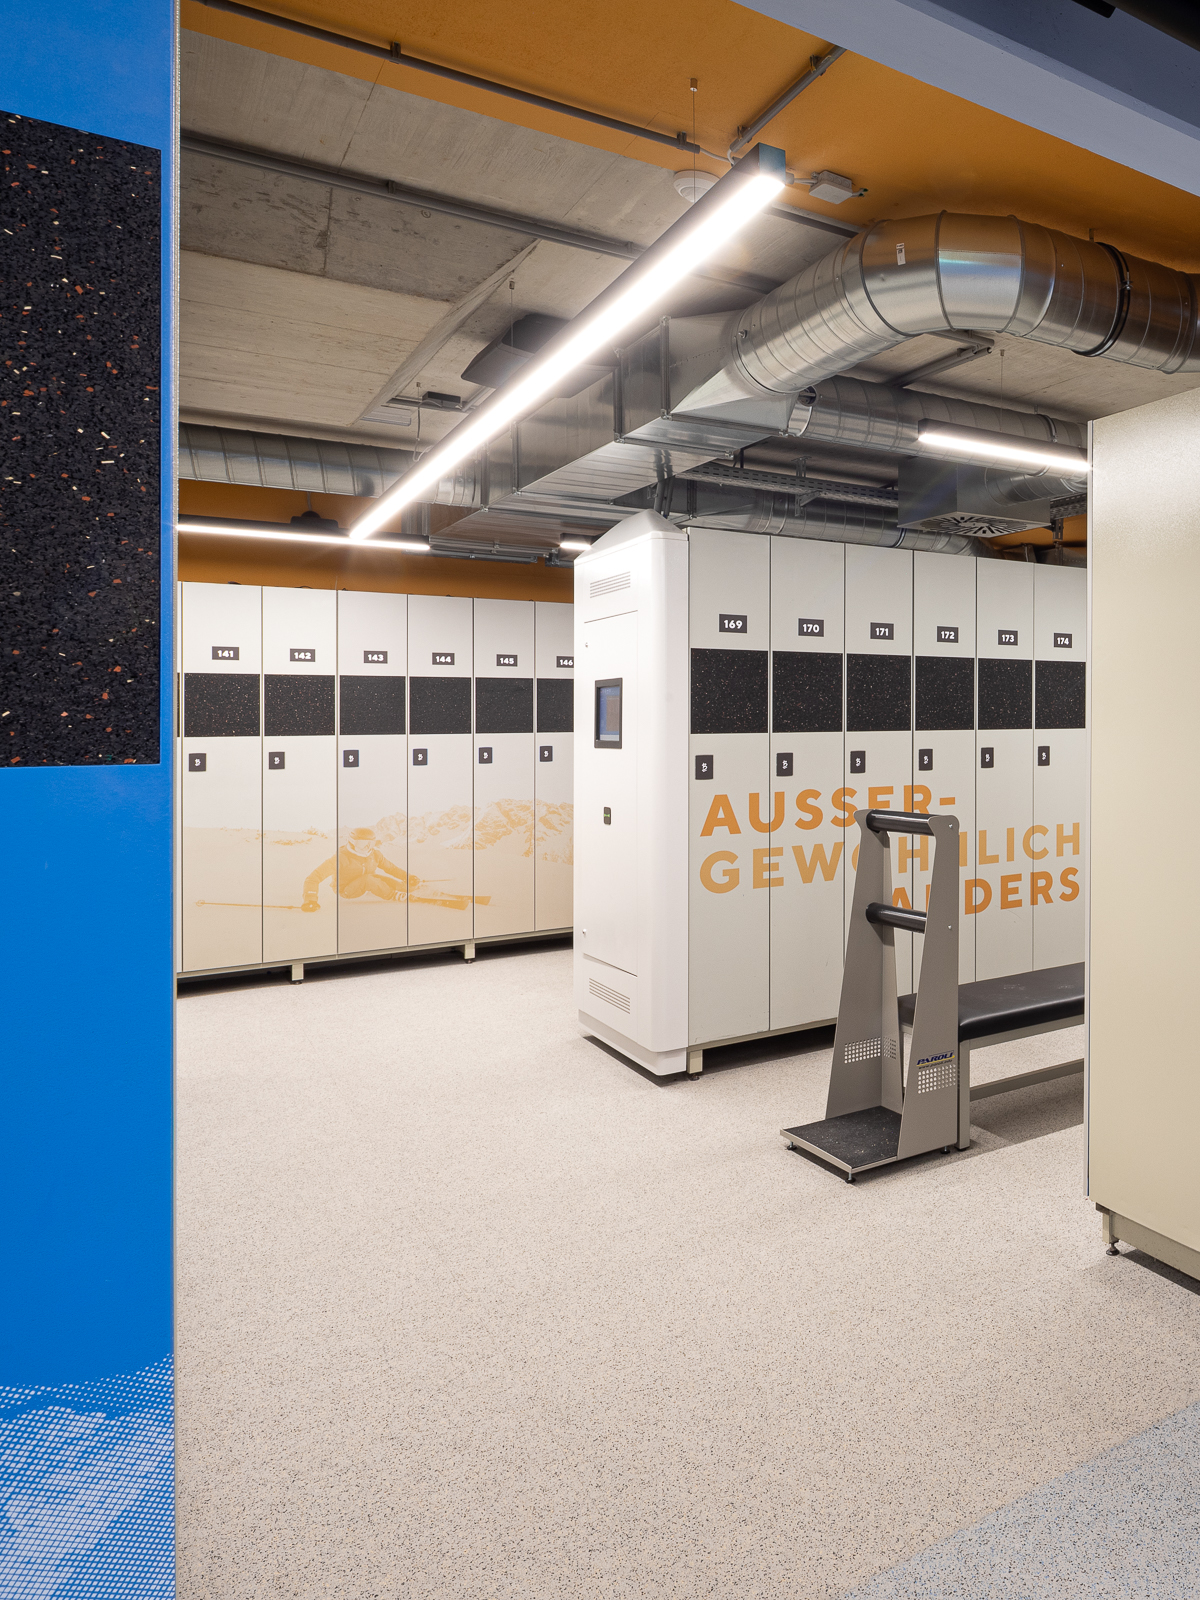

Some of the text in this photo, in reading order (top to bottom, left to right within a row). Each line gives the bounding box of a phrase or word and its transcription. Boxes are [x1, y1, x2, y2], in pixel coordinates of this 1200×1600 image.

[723, 619, 743, 629] 169
[802, 623, 820, 633] 170
[875, 627, 889, 637] 171
[940, 630, 955, 640] 172
[1001, 634, 1015, 643] 173
[1057, 637, 1070, 645] 174
[217, 649, 234, 658] 141
[294, 651, 312, 660] 142
[367, 653, 384, 662] 143
[435, 655, 452, 663] 144
[499, 657, 515, 665] 145
[700, 785, 956, 837] AUSSER-
[700, 823, 1080, 894] GEWHLICH
[892, 867, 1080, 915] ADERS
